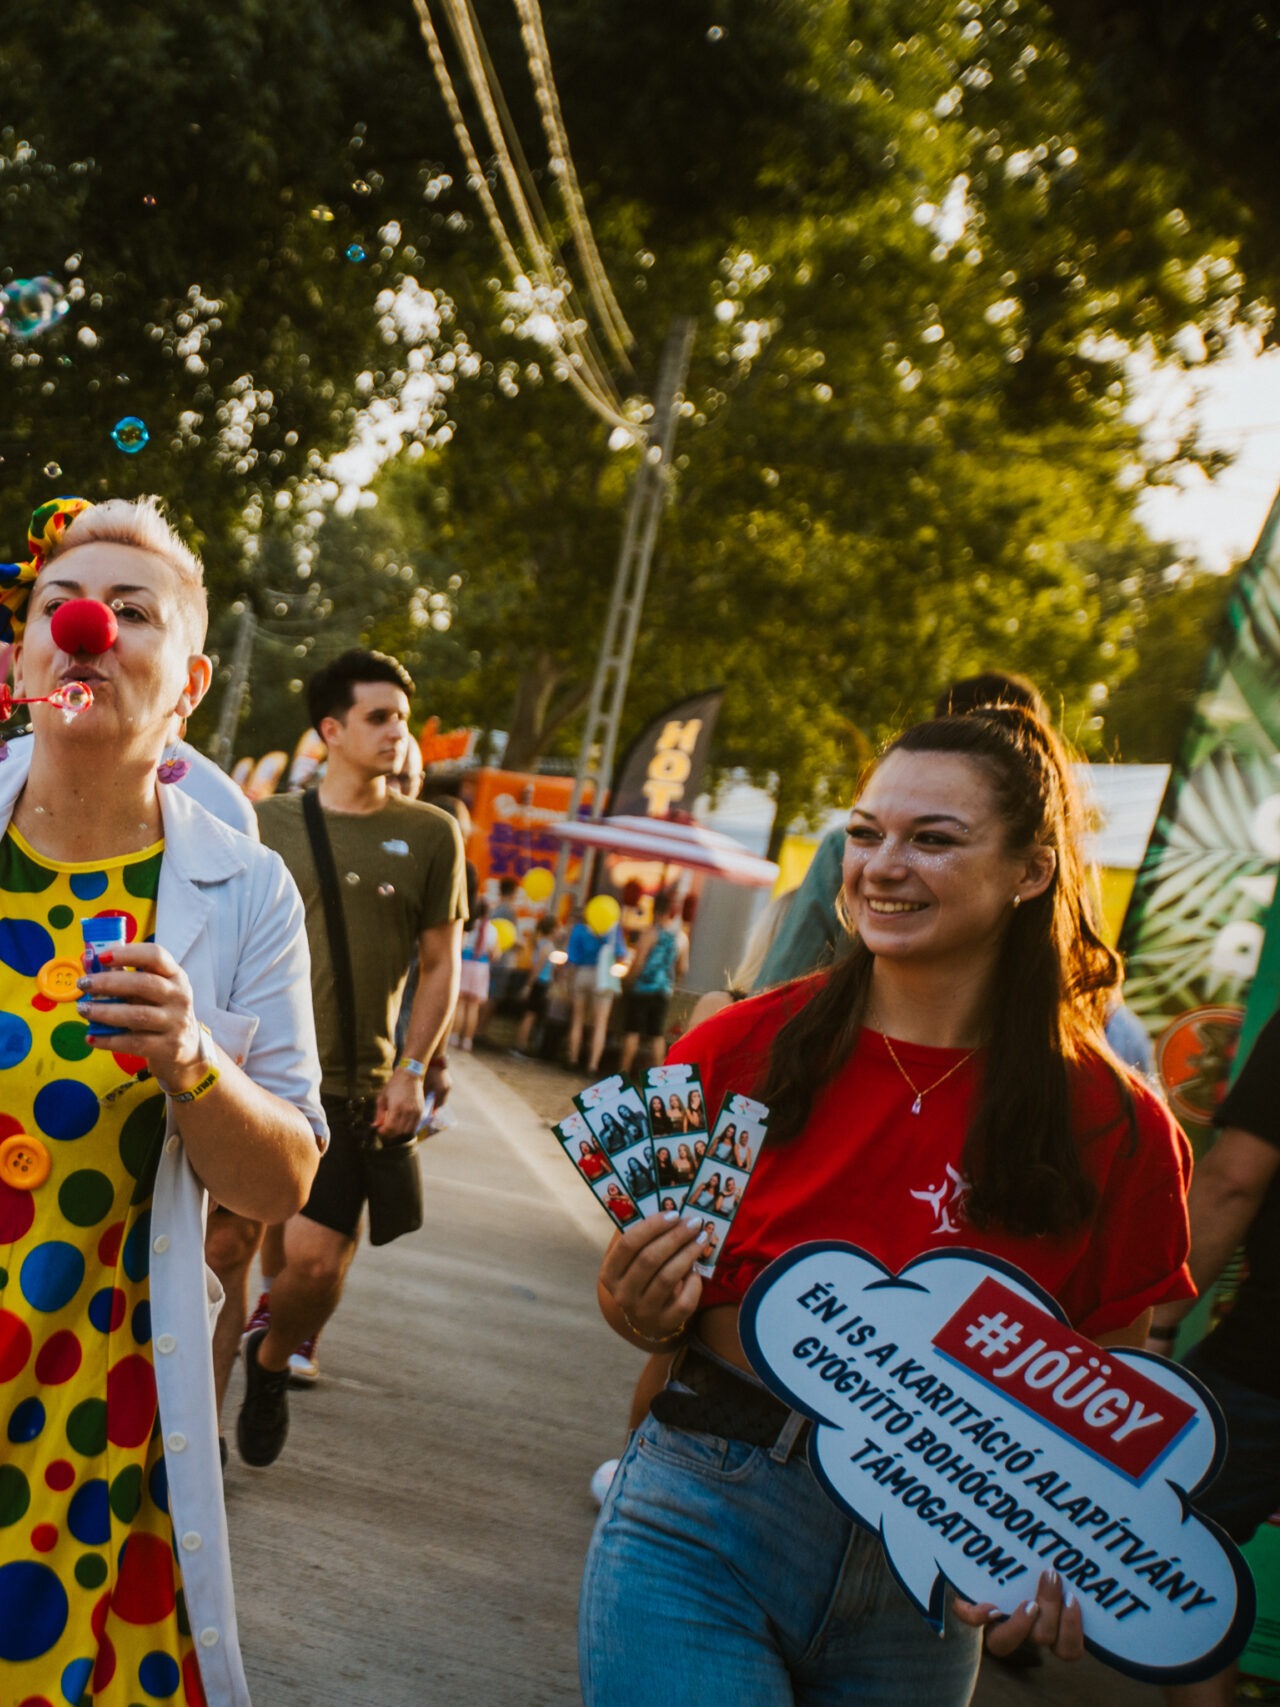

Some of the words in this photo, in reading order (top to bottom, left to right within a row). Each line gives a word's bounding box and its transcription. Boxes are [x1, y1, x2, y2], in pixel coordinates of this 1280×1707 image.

[642, 718, 704, 818] HOT
[796, 1282, 848, 1324] ÉN
[835, 1315, 876, 1346] IS
[864, 1342, 899, 1368] A
[888, 1357, 1045, 1473] KARITÁCIÓ
[1023, 1470, 1218, 1612] ALAPÍTVÁNY
[964, 1311, 1164, 1442] #JÓÜGY
[792, 1336, 923, 1435] GYÓGYÍTÓ
[904, 1426, 1152, 1620] BOHÓCDOKTORAIT
[849, 1437, 1028, 1586] TÁMOGATOM!
